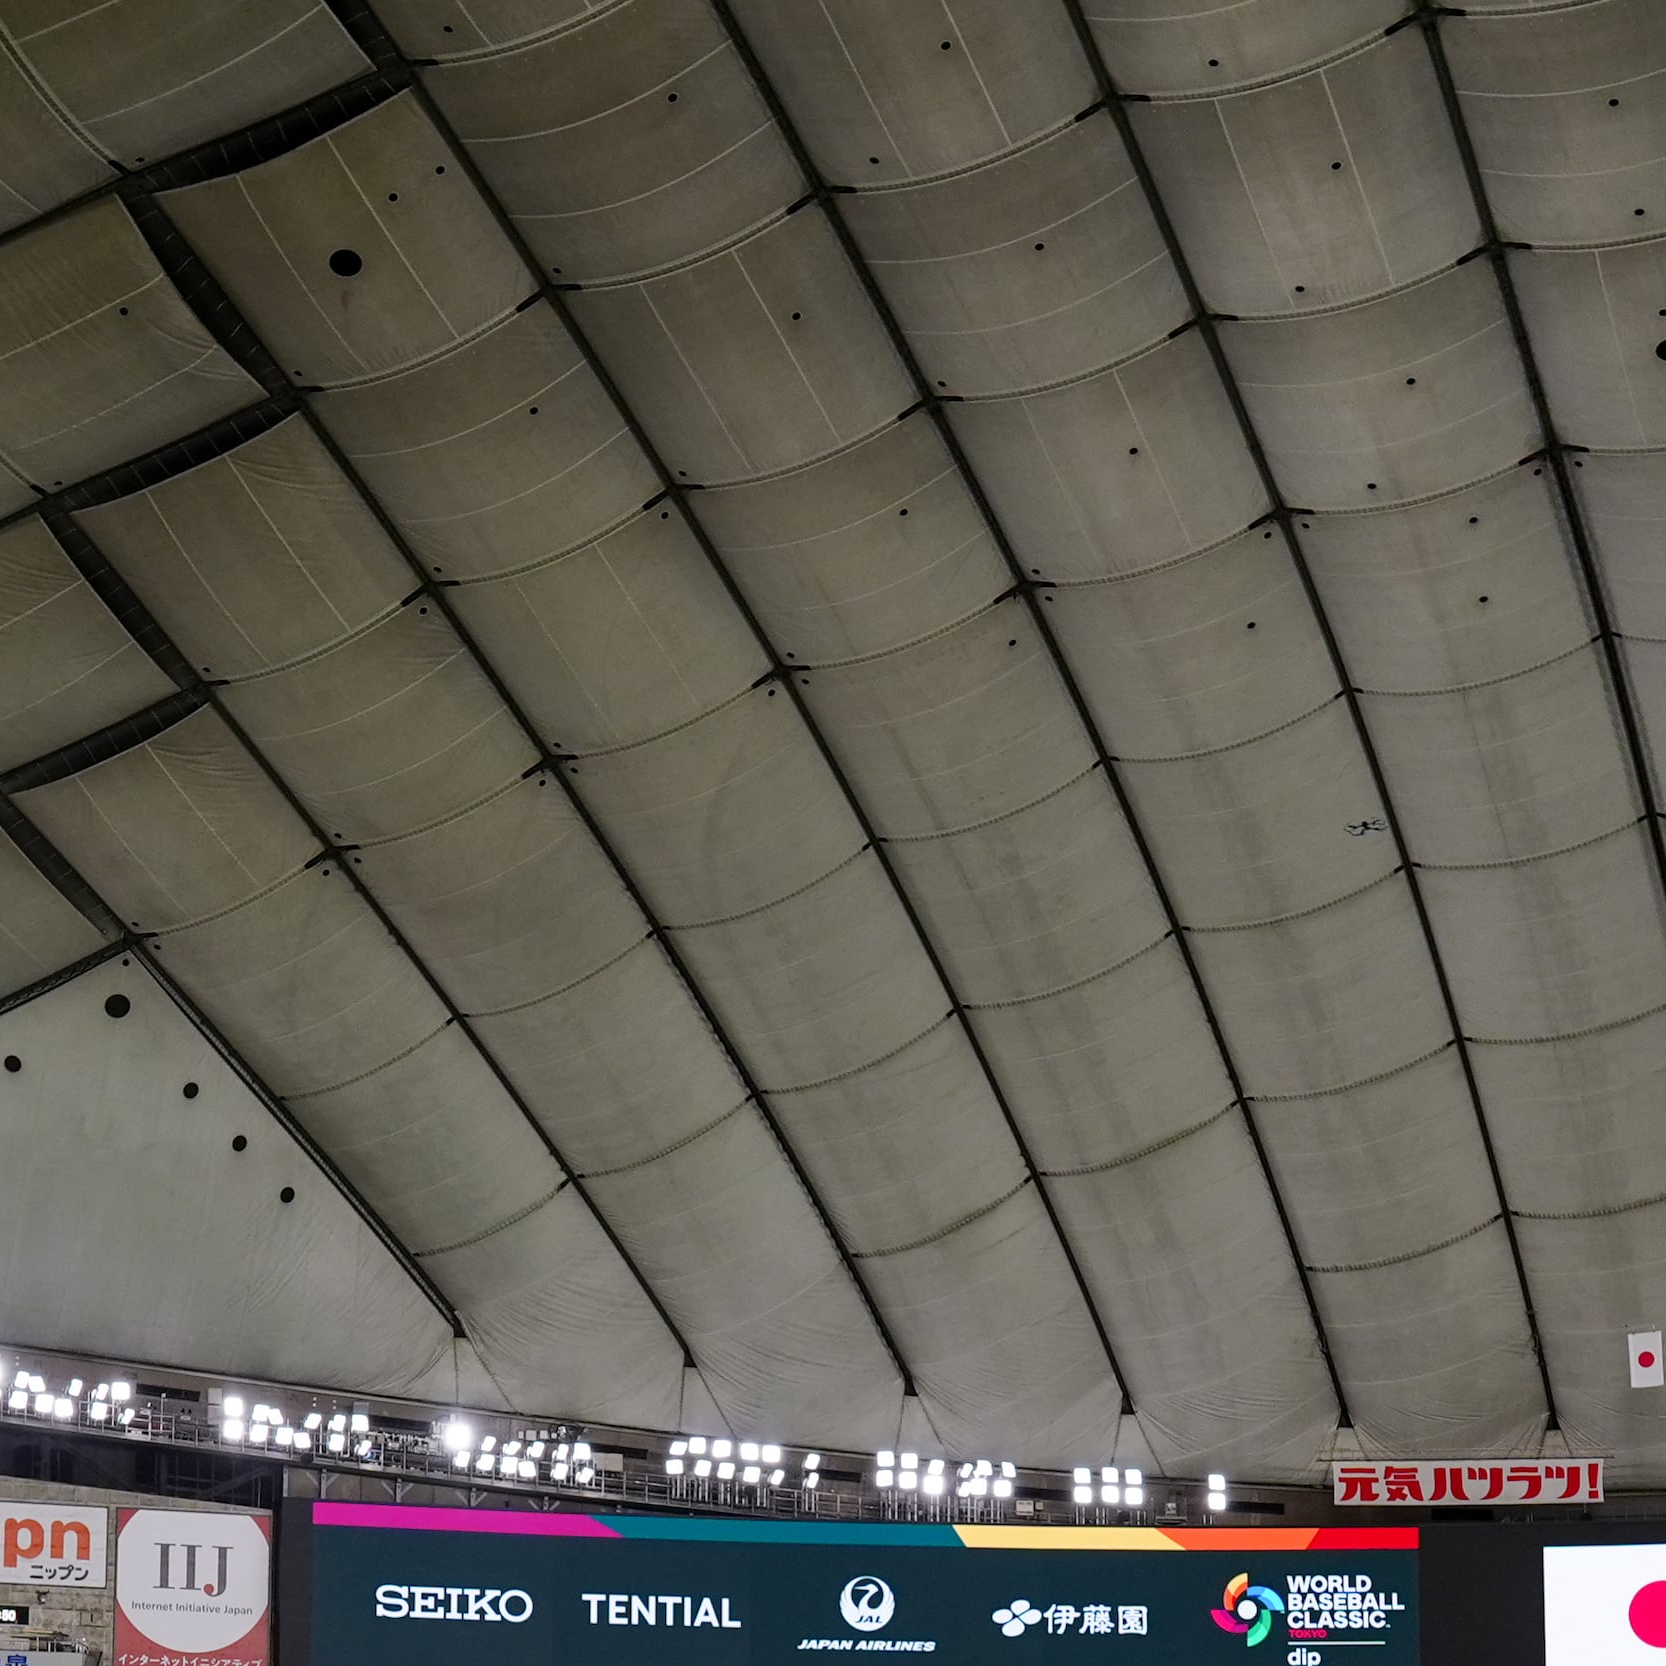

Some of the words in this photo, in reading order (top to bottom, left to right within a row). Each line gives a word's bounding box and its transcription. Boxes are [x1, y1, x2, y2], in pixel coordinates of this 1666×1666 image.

[1338, 1461, 1601, 1502] 元気ハツラツ!
[29, 1563, 89, 1582] ニップン
[152, 1542, 234, 1598] IIJ
[1286, 1575, 1373, 1593] WORLD
[131, 1601, 173, 1612] Internet
[175, 1603, 221, 1614] Initiative
[223, 1605, 253, 1616] Japan
[375, 1583, 534, 1624] SEIKO
[581, 1592, 742, 1629] TENTIAL
[1287, 1592, 1406, 1611] BASEBALL
[855, 1615, 883, 1624] JAL
[1042, 1603, 1148, 1636] 伊藤園
[1287, 1610, 1386, 1629] CLASSIC
[1288, 1629, 1328, 1639] TOKYO
[797, 1639, 853, 1650] JAPAN
[855, 1640, 936, 1652] AIRLINES
